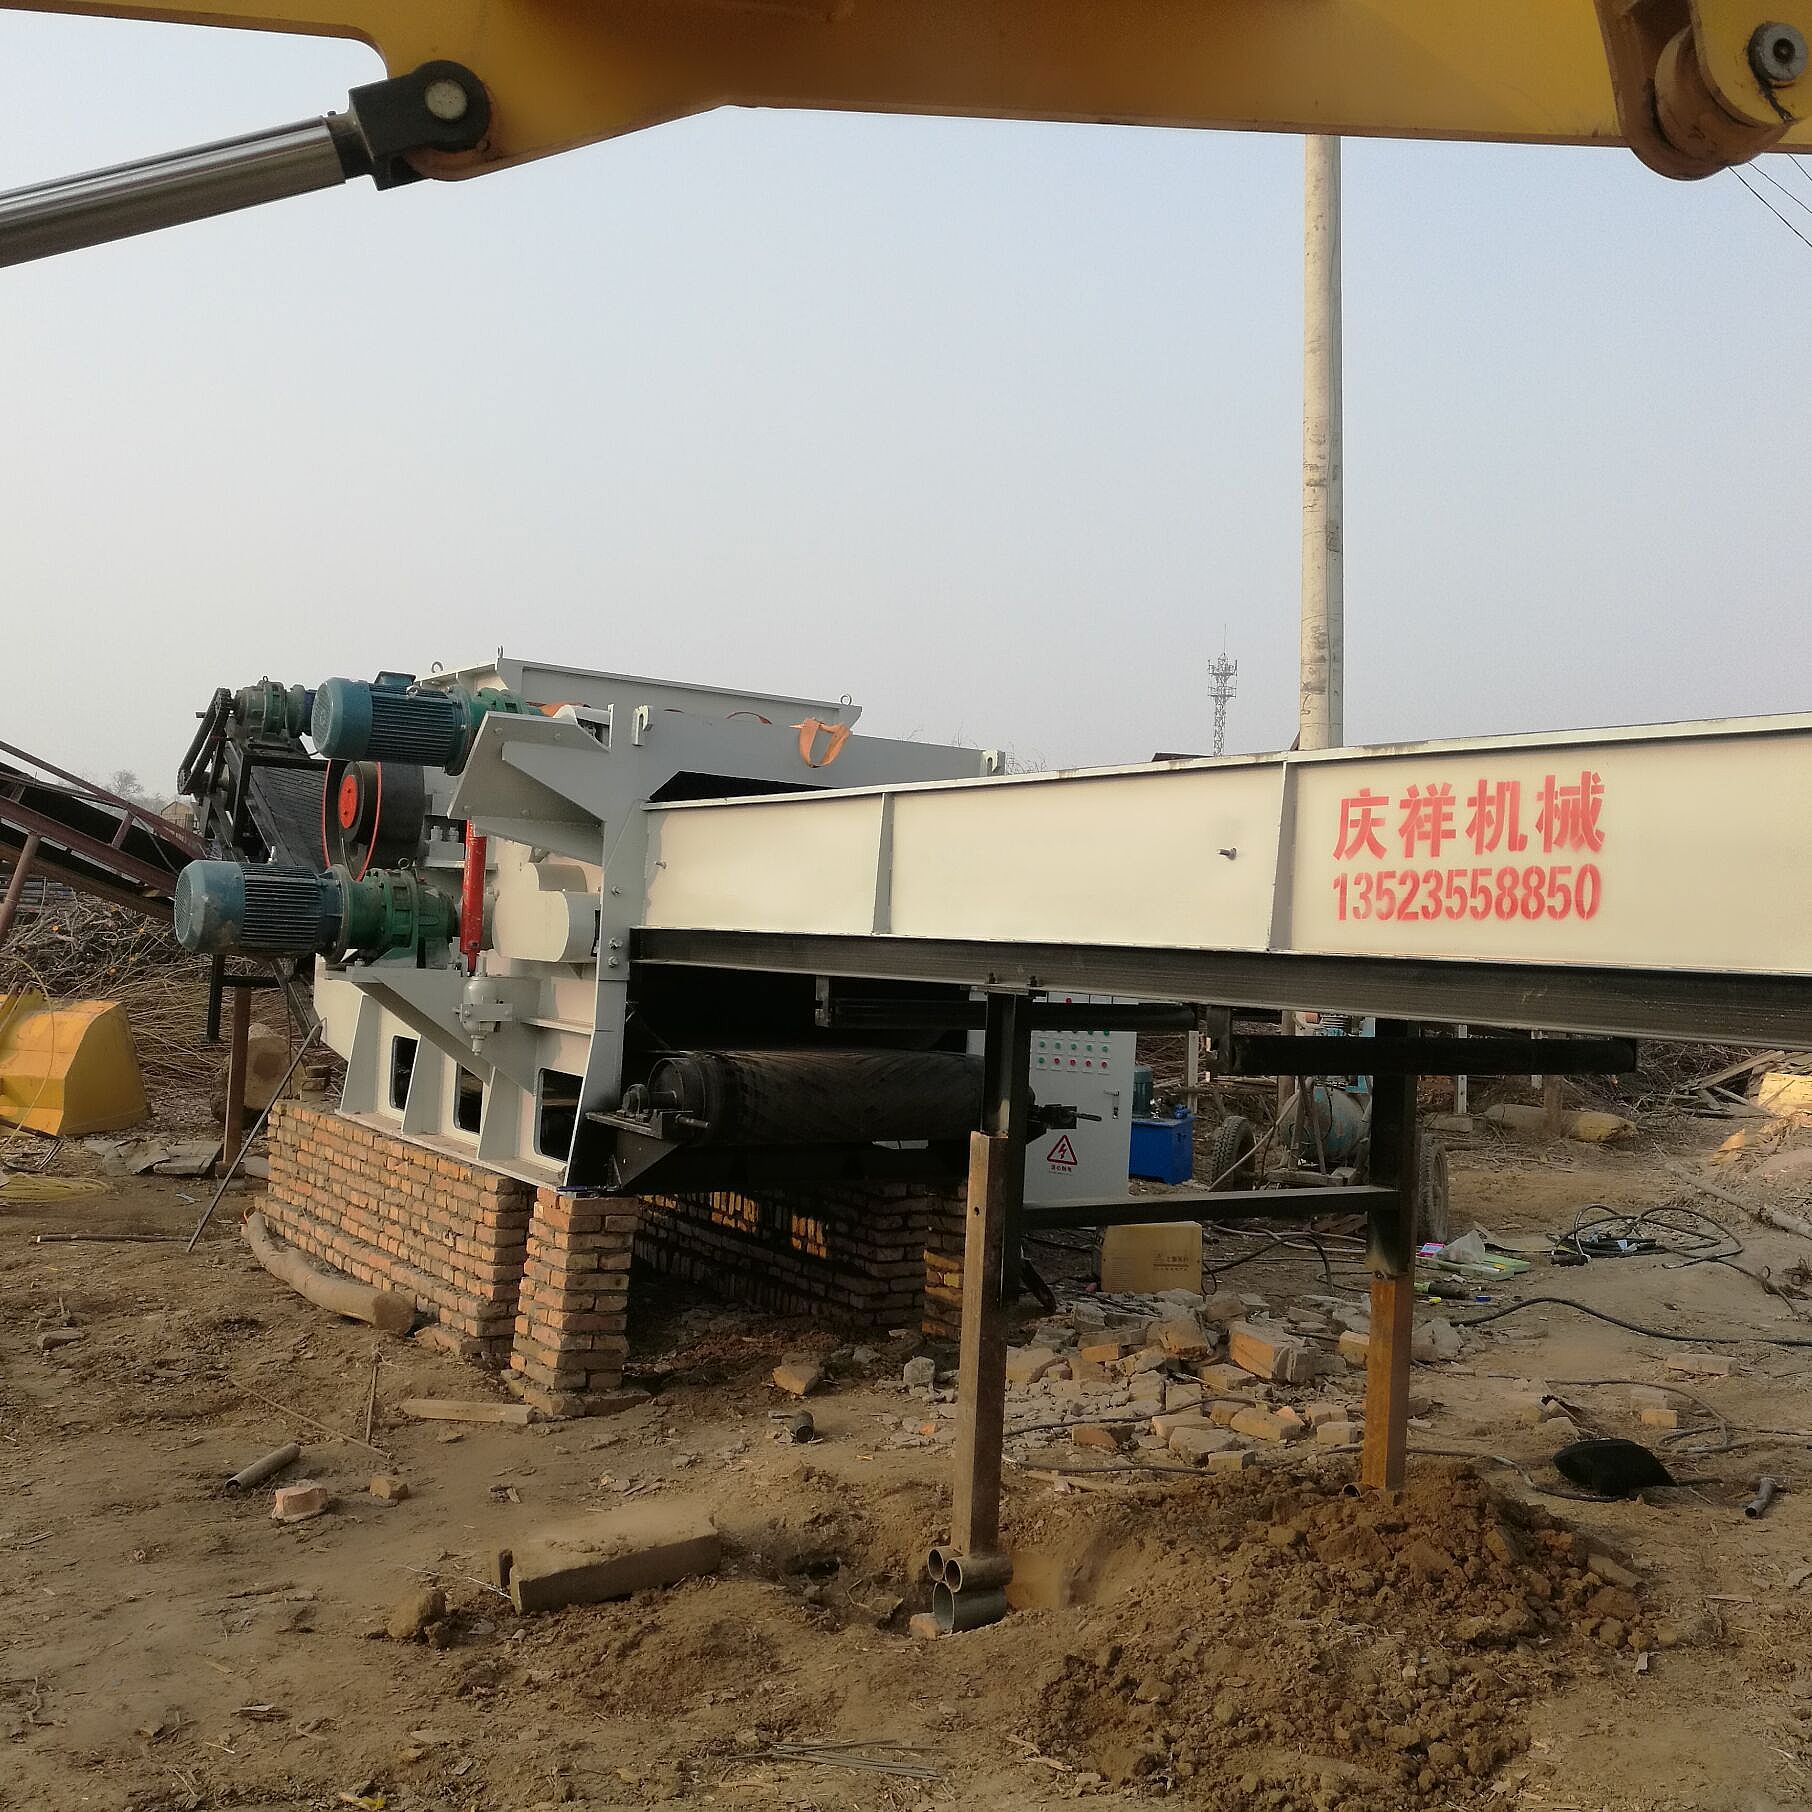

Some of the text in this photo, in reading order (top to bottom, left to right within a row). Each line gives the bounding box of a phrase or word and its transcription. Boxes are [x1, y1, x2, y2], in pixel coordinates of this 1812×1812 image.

[1332, 770, 1605, 860] 庆祥机械
[1332, 864, 1602, 921] 13523558850
